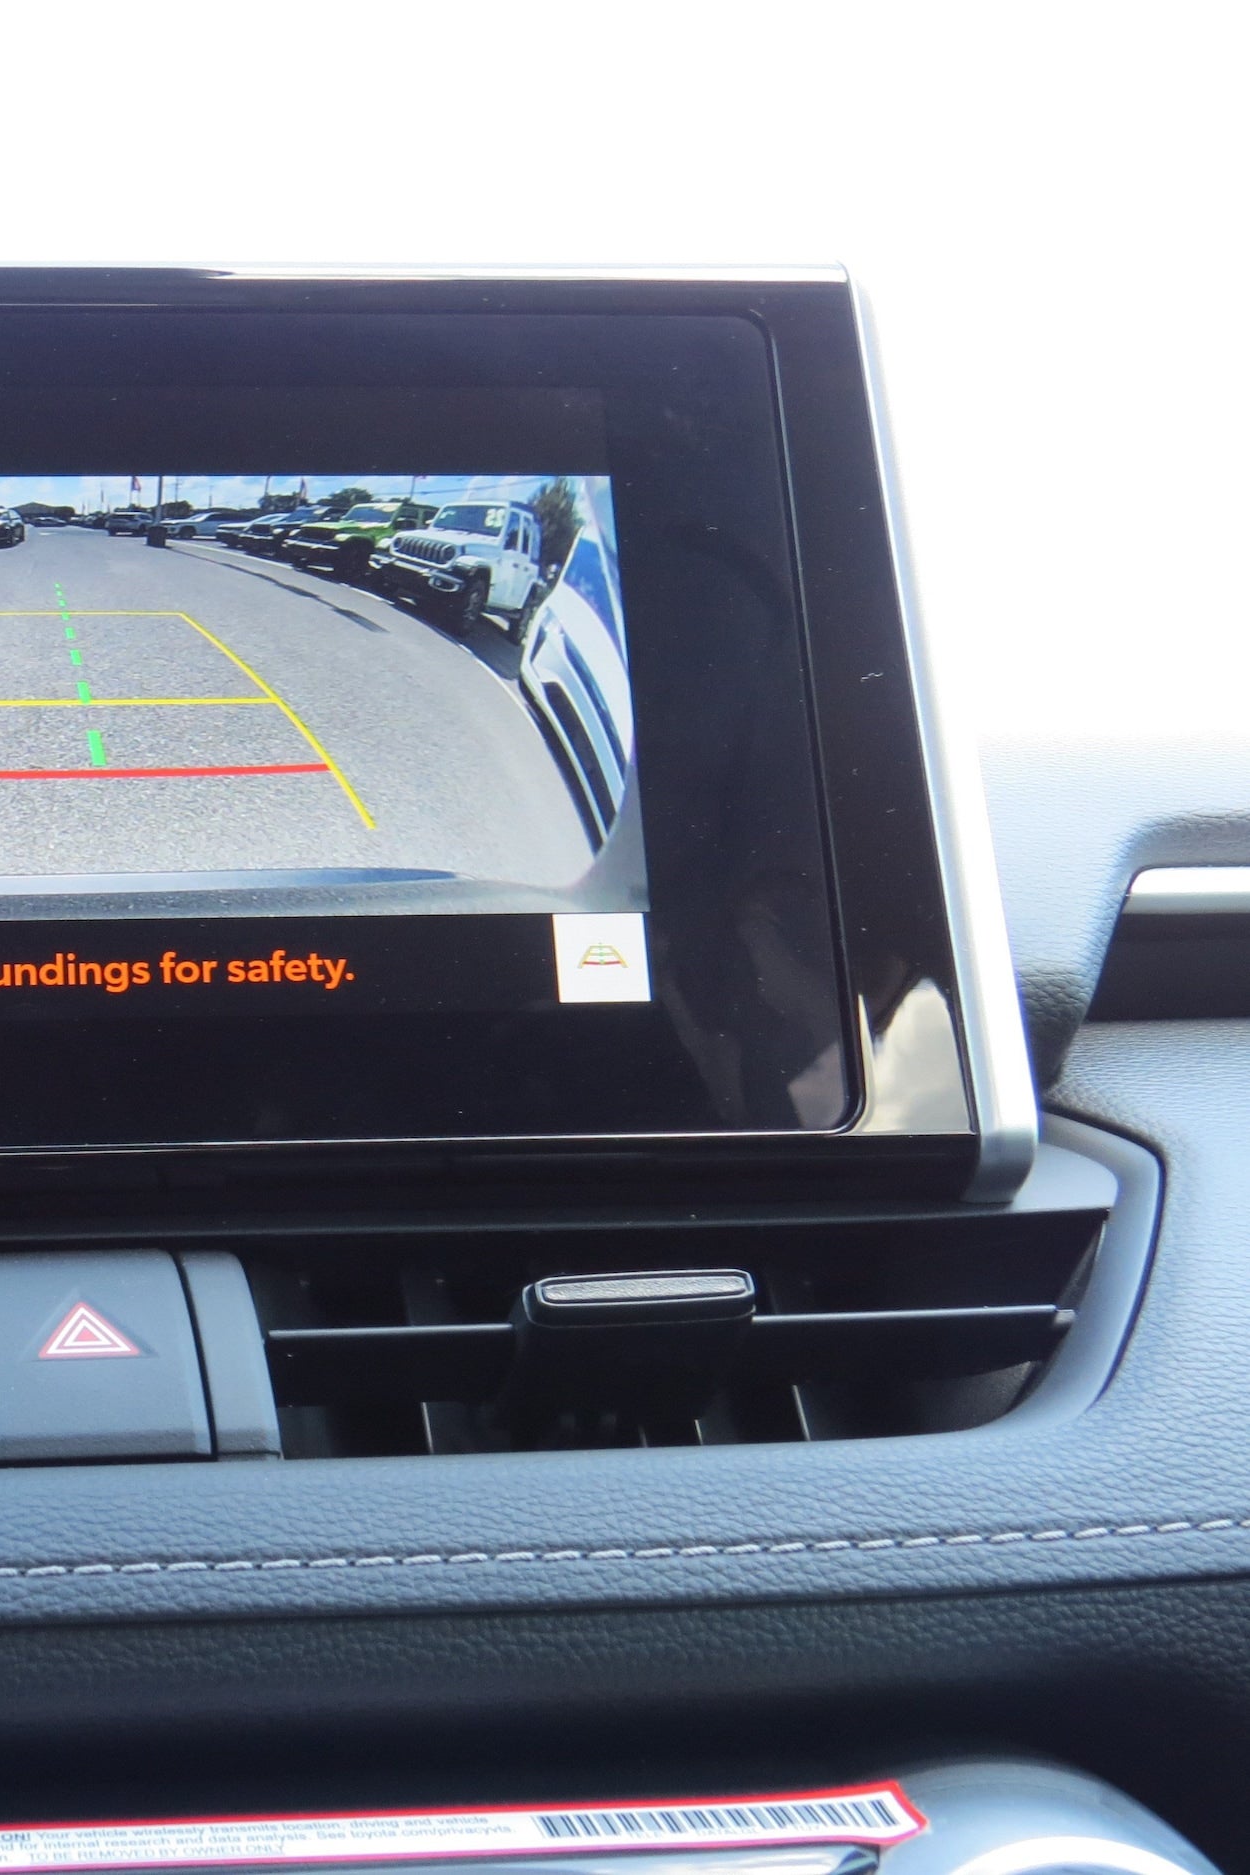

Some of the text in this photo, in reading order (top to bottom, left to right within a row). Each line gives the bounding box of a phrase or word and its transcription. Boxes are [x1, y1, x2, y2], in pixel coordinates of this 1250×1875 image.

[158, 951, 218, 984] for
[226, 949, 355, 990] safety.
[0, 1832, 31, 1842] ON!
[36, 1830, 70, 1840] Your
[75, 1829, 127, 1839] vehicle
[132, 1826, 205, 1839] wirelessly
[210, 1823, 278, 1834] transmits
[350, 1818, 400, 1829] driving
[404, 1817, 432, 1827] and
[436, 1815, 488, 1825] vehicle
[19, 1840, 38, 1850] for
[44, 1839, 100, 1849] internal
[105, 1836, 171, 1848] research
[176, 1835, 203, 1846] and
[208, 1833, 241, 1844] data
[246, 1831, 312, 1843] analysis.
[316, 1830, 346, 1840] See
[29, 1843, 284, 1862] TO BE REMOVED BY OWNER ONLY
